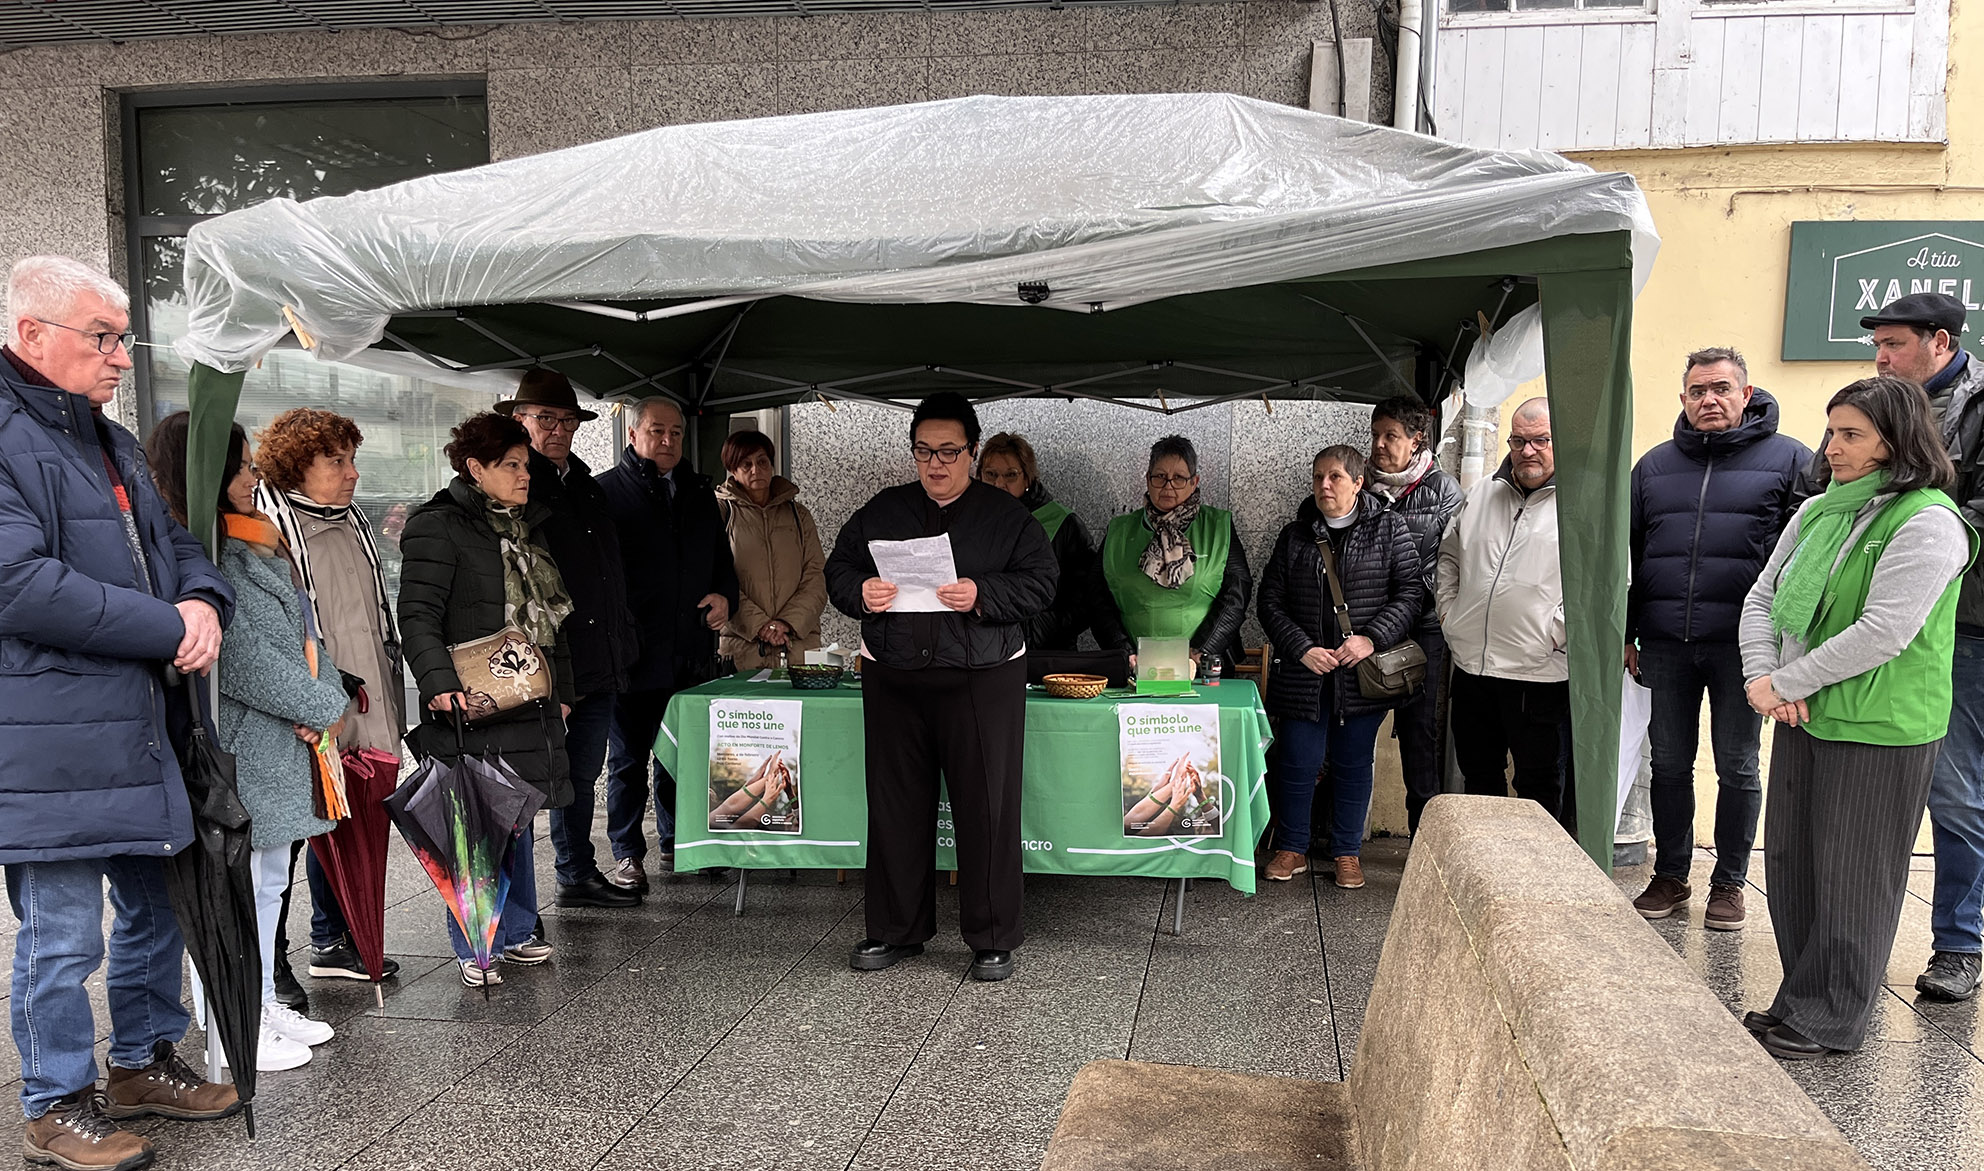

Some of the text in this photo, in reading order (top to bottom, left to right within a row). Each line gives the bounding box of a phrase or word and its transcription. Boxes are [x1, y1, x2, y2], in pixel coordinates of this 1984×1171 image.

[1907, 246, 1961, 269] A túa
[717, 710, 773, 720] O símbolo
[717, 721, 739, 730] que
[1127, 716, 1136, 725] O
[1127, 725, 1202, 737] que nos une
